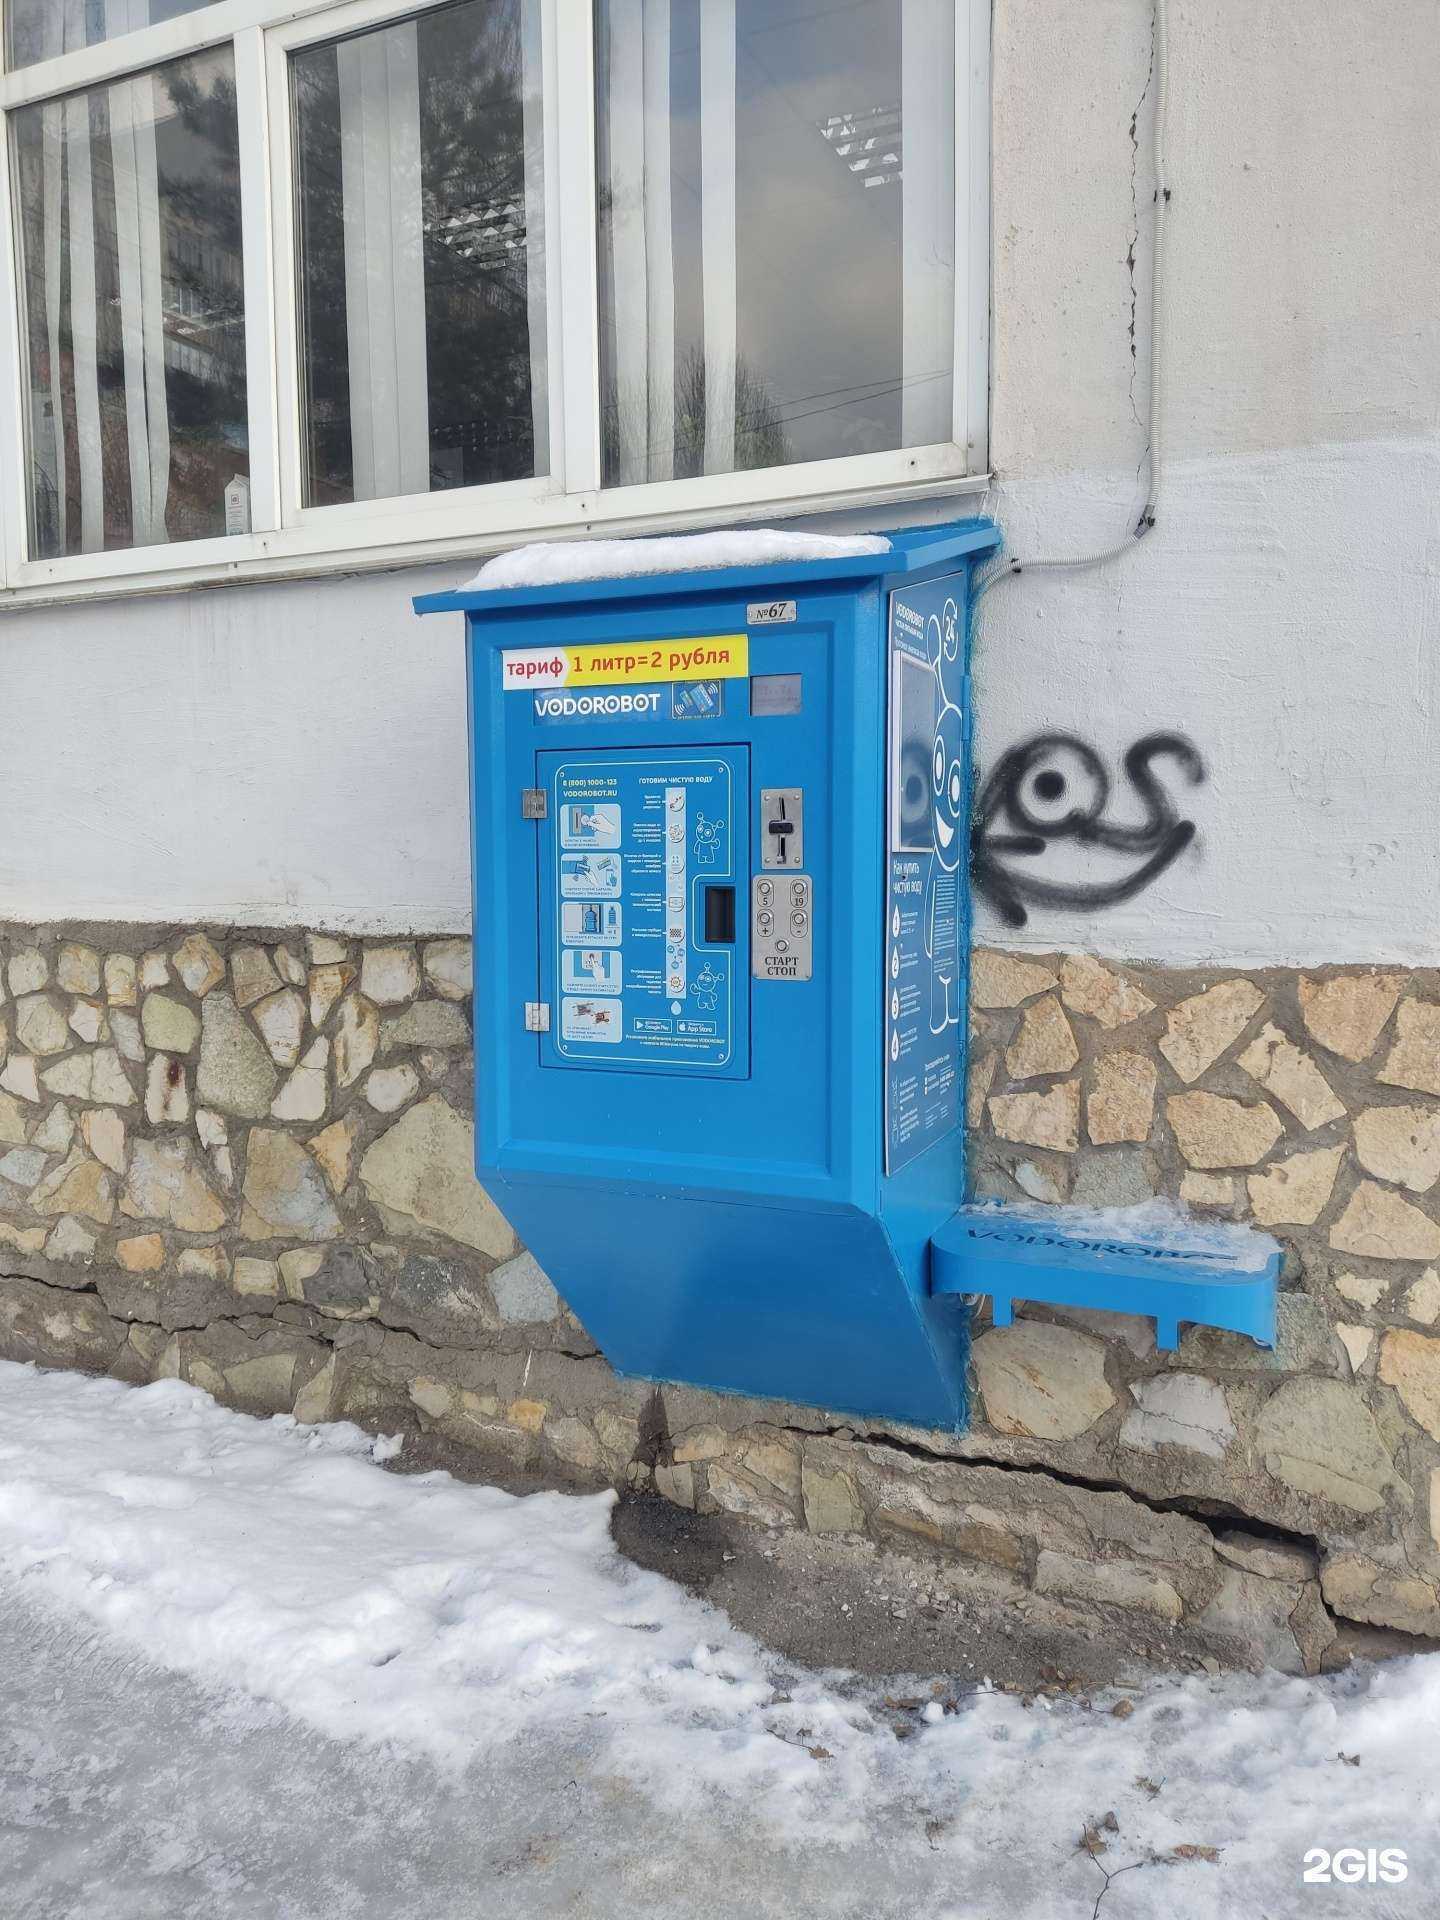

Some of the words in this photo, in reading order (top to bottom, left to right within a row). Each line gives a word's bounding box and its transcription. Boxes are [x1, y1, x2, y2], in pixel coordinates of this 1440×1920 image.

[757, 602, 787, 619] №67
[506, 656, 564, 678] тариф
[573, 656, 583, 673] 1
[669, 647, 730, 672] рубля
[535, 693, 661, 717] VODOROBOT
[638, 777, 668, 785] ГОТОВИМ
[695, 775, 714, 784] ВОДУ
[763, 897, 768, 906] 5
[795, 897, 804, 907] 19
[765, 956, 799, 966] СТАРТ
[767, 966, 797, 976] СТОП
